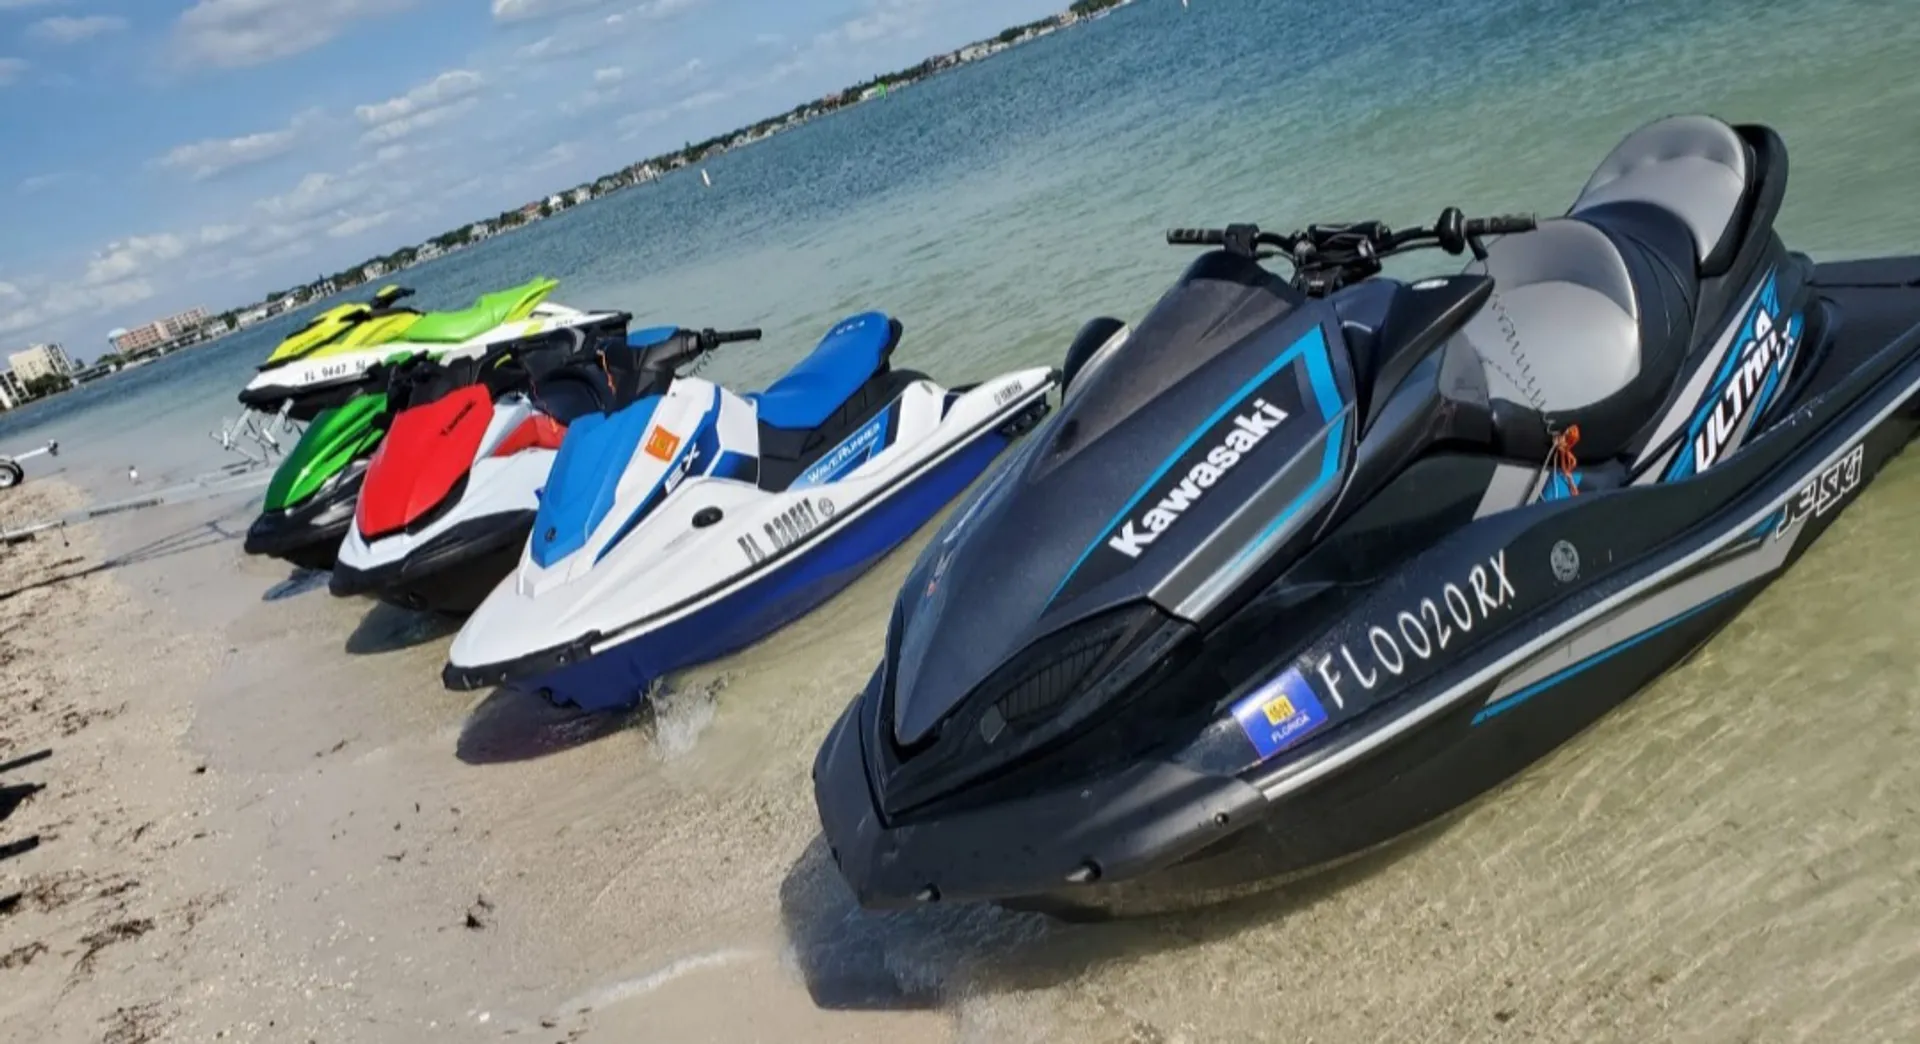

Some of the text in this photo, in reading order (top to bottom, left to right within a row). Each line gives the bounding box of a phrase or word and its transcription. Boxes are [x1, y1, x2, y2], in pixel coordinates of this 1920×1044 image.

[1695, 307, 1778, 474] ULTRA
[1107, 397, 1290, 558] Kawasaki
[1271, 712, 1312, 744] FLORIDA
